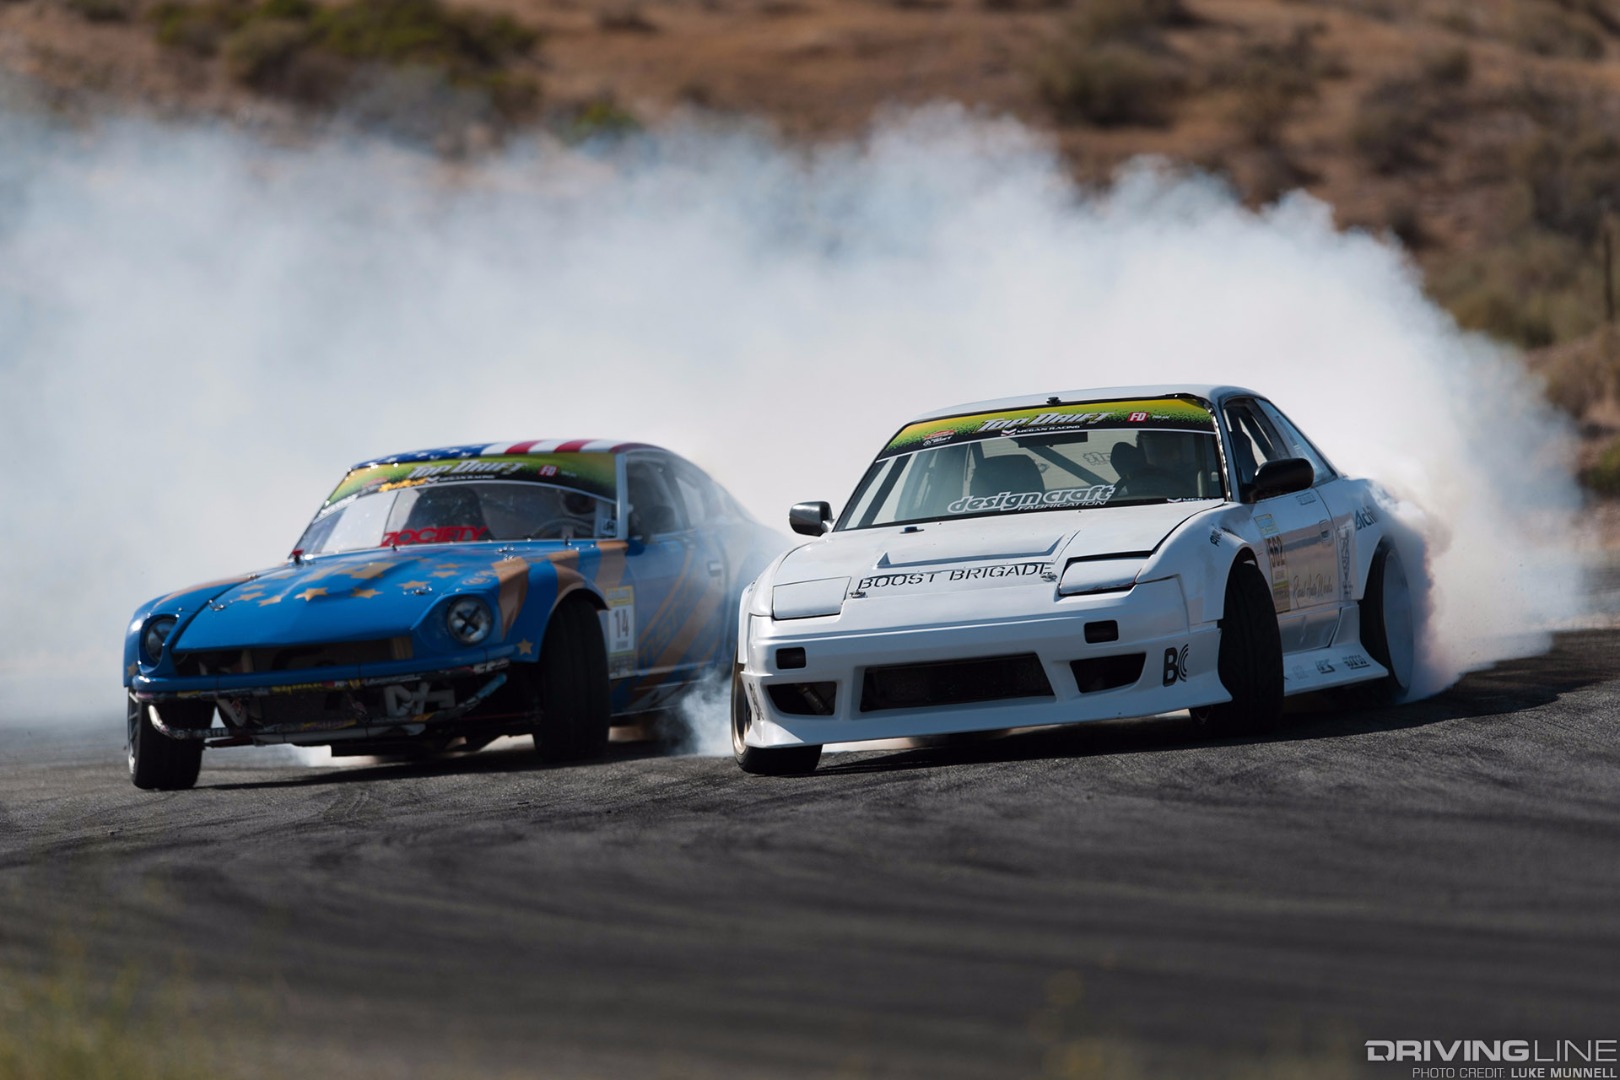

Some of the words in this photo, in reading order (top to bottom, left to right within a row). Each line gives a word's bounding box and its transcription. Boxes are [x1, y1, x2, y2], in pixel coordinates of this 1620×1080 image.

[947, 491, 1043, 514] design
[1043, 485, 1116, 504] craft
[1018, 501, 1107, 511] FABRICATION
[857, 572, 938, 590] BOOST
[949, 562, 1052, 582] BRIGADE
[614, 609, 629, 639] 14
